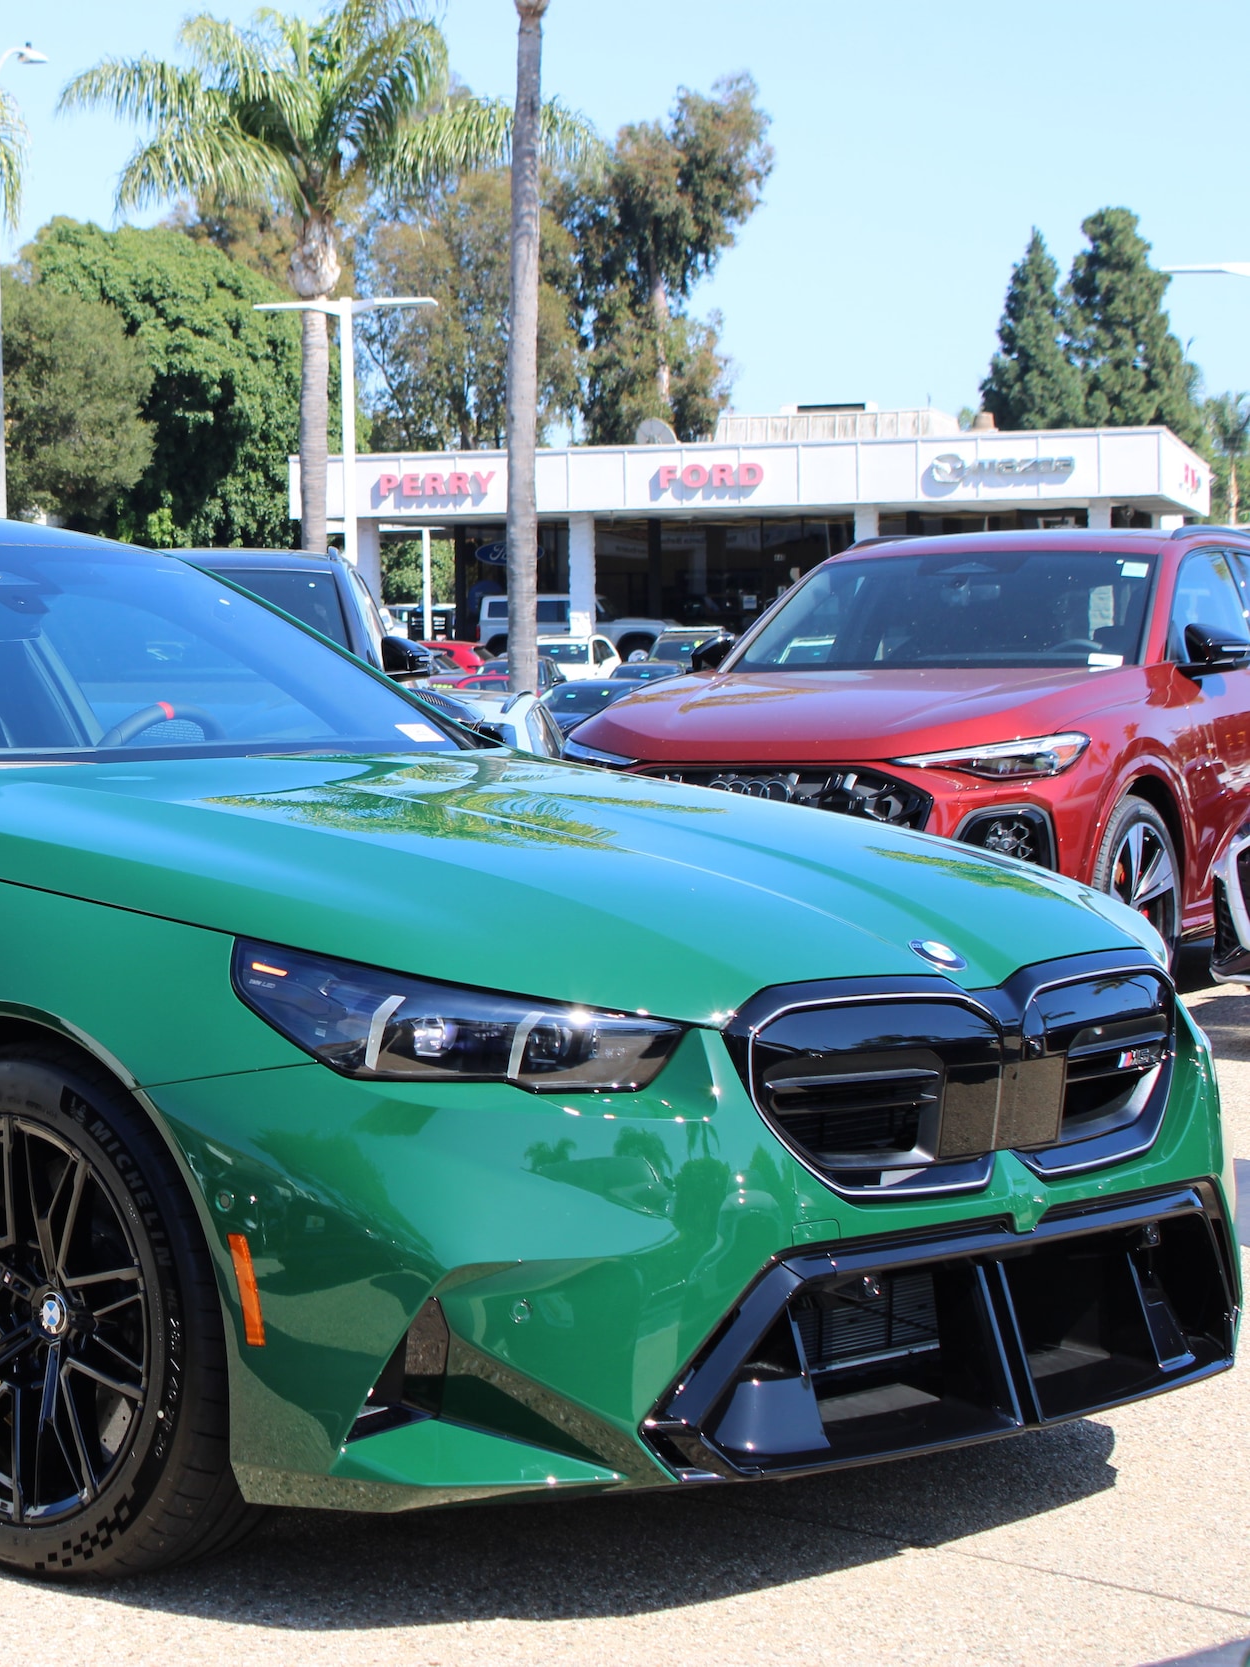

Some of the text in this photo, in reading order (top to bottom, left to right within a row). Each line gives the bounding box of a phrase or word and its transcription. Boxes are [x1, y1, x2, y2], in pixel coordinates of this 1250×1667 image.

[379, 471, 496, 497] PERRY
[659, 463, 764, 489] FORD
[89, 1119, 173, 1267] MICHELIN
